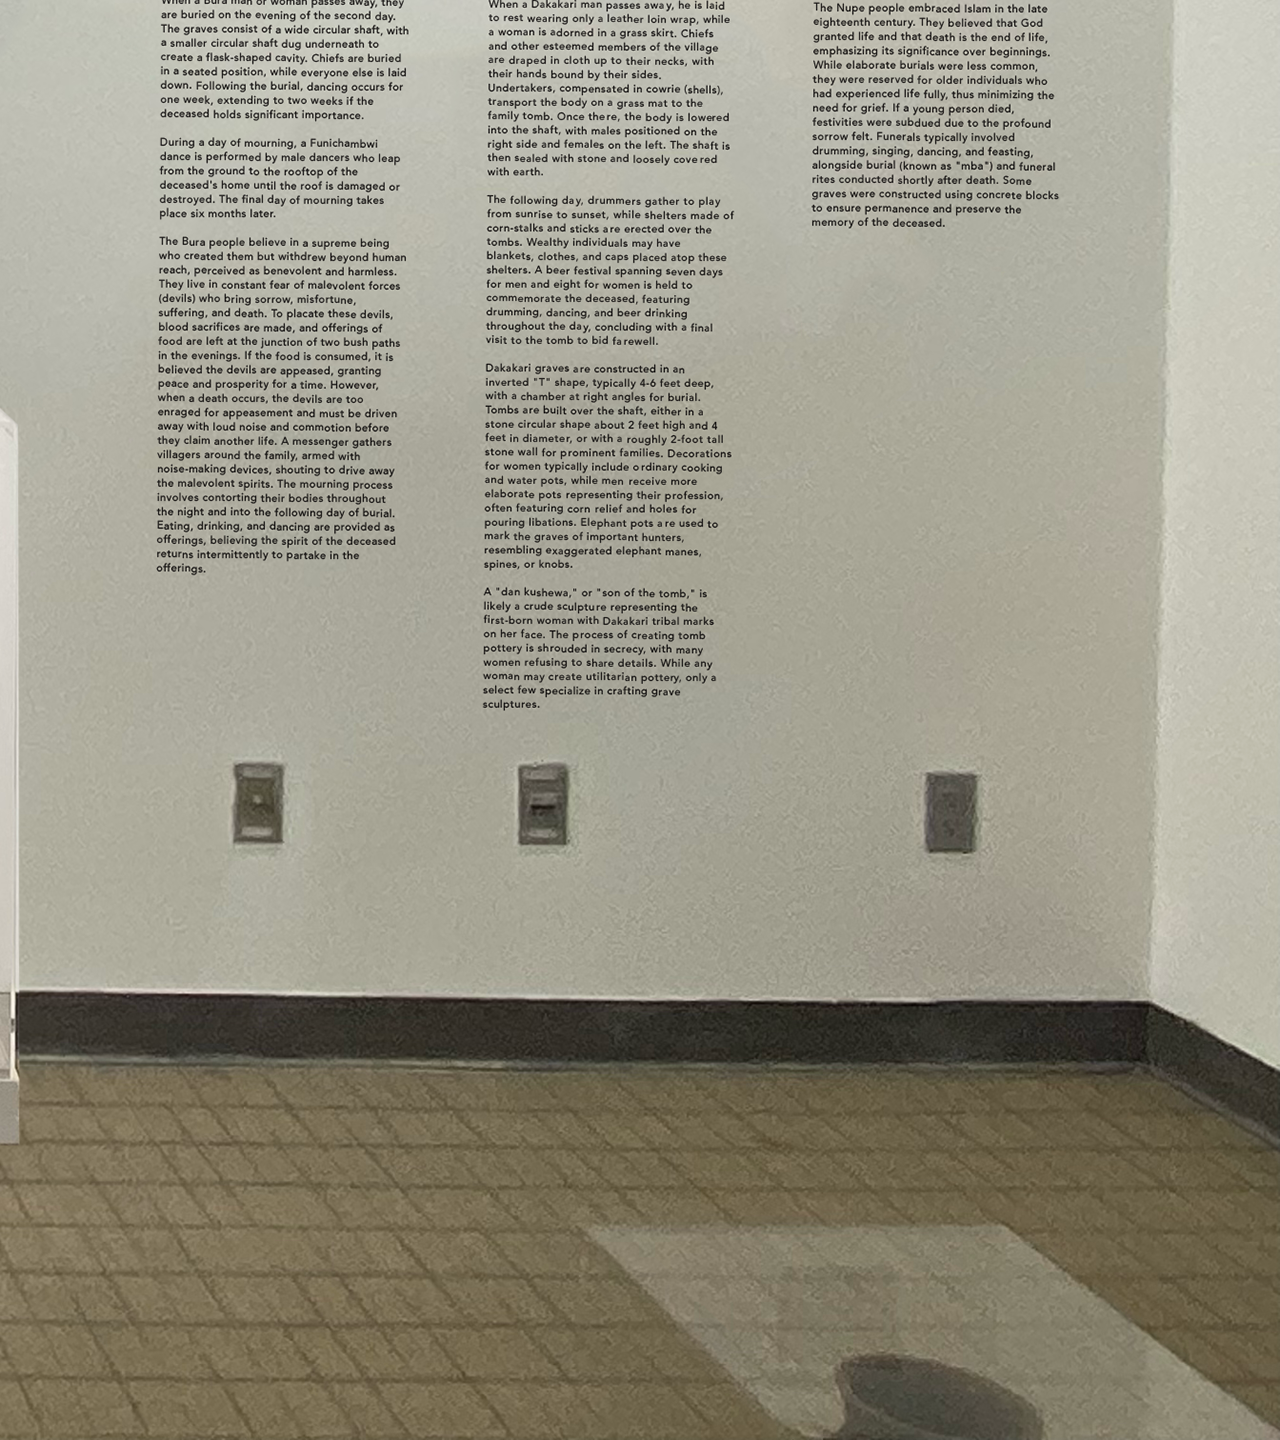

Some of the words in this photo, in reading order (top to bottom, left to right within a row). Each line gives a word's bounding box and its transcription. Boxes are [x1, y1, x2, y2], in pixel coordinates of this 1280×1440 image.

[813, 1, 833, 13] The
[836, 2, 866, 16] Nupe
[868, 2, 905, 16] people
[908, 2, 961, 14] embraced
[964, 3, 992, 14] Islam
[994, 3, 1005, 14] in
[1006, 3, 1025, 14] the
[1027, 3, 1048, 14] late
[488, 40, 508, 51] and
[510, 40, 540, 51] other
[542, 41, 595, 52] esteemed
[597, 41, 647, 52] members
[649, 41, 661, 52] of
[663, 41, 682, 52] the
[684, 41, 719, 55] village
[812, 45, 879, 59] emphasizing
[881, 45, 895, 56] its
[897, 45, 960, 58] significance
[962, 49, 987, 57] over
[989, 46, 1051, 59] beginnings.
[160, 79, 193, 90] down.
[195, 80, 247, 93] Following
[249, 80, 268, 91] the
[270, 80, 304, 92] burial,
[306, 81, 348, 94] dancing
[350, 84, 386, 92] occurs
[387, 81, 404, 92] for
[812, 133, 849, 141] sorrow
[851, 131, 873, 141] felt.
[876, 131, 921, 142] Funerals
[923, 132, 969, 145] typically
[970, 132, 1015, 142] involved
[486, 166, 510, 177] with
[512, 166, 544, 177] earth.
[159, 207, 188, 221] place
[190, 208, 205, 219] six
[207, 208, 247, 219] months
[249, 208, 276, 219] later.
[811, 219, 855, 230] memory
[857, 216, 869, 227] of
[871, 216, 889, 227] the
[892, 217, 946, 228] deceased.
[158, 293, 196, 305] (devils)
[198, 293, 221, 303] who
[223, 293, 252, 307] bring
[254, 296, 294, 305] sorrow,
[296, 293, 357, 306] misfortune,
[484, 420, 515, 429] stone
[517, 419, 557, 429] circular
[559, 419, 591, 432] shape
[593, 420, 625, 430] about
[628, 420, 635, 430] 2
[637, 419, 660, 430] feet
[662, 420, 686, 432] high
[688, 421, 709, 431] and
[711, 421, 718, 431] 4
[156, 477, 175, 488] the
[177, 477, 235, 488] malevolent
[238, 479, 274, 492] spirits.
[276, 478, 297, 489] The
[299, 479, 350, 491] mourning
[352, 481, 393, 492] process
[484, 544, 543, 557] resembling
[545, 545, 613, 558] exaggerated
[615, 545, 662, 558] elephant
[665, 549, 702, 558] manes,
[156, 562, 206, 576] offerings.
[483, 614, 533, 625] first-born
[536, 617, 574, 625] woman
[576, 615, 600, 625] with
[602, 616, 649, 626] Dakakari
[651, 616, 680, 626] tribal
[683, 616, 715, 626] marks
[482, 699, 541, 712] sculptures.
